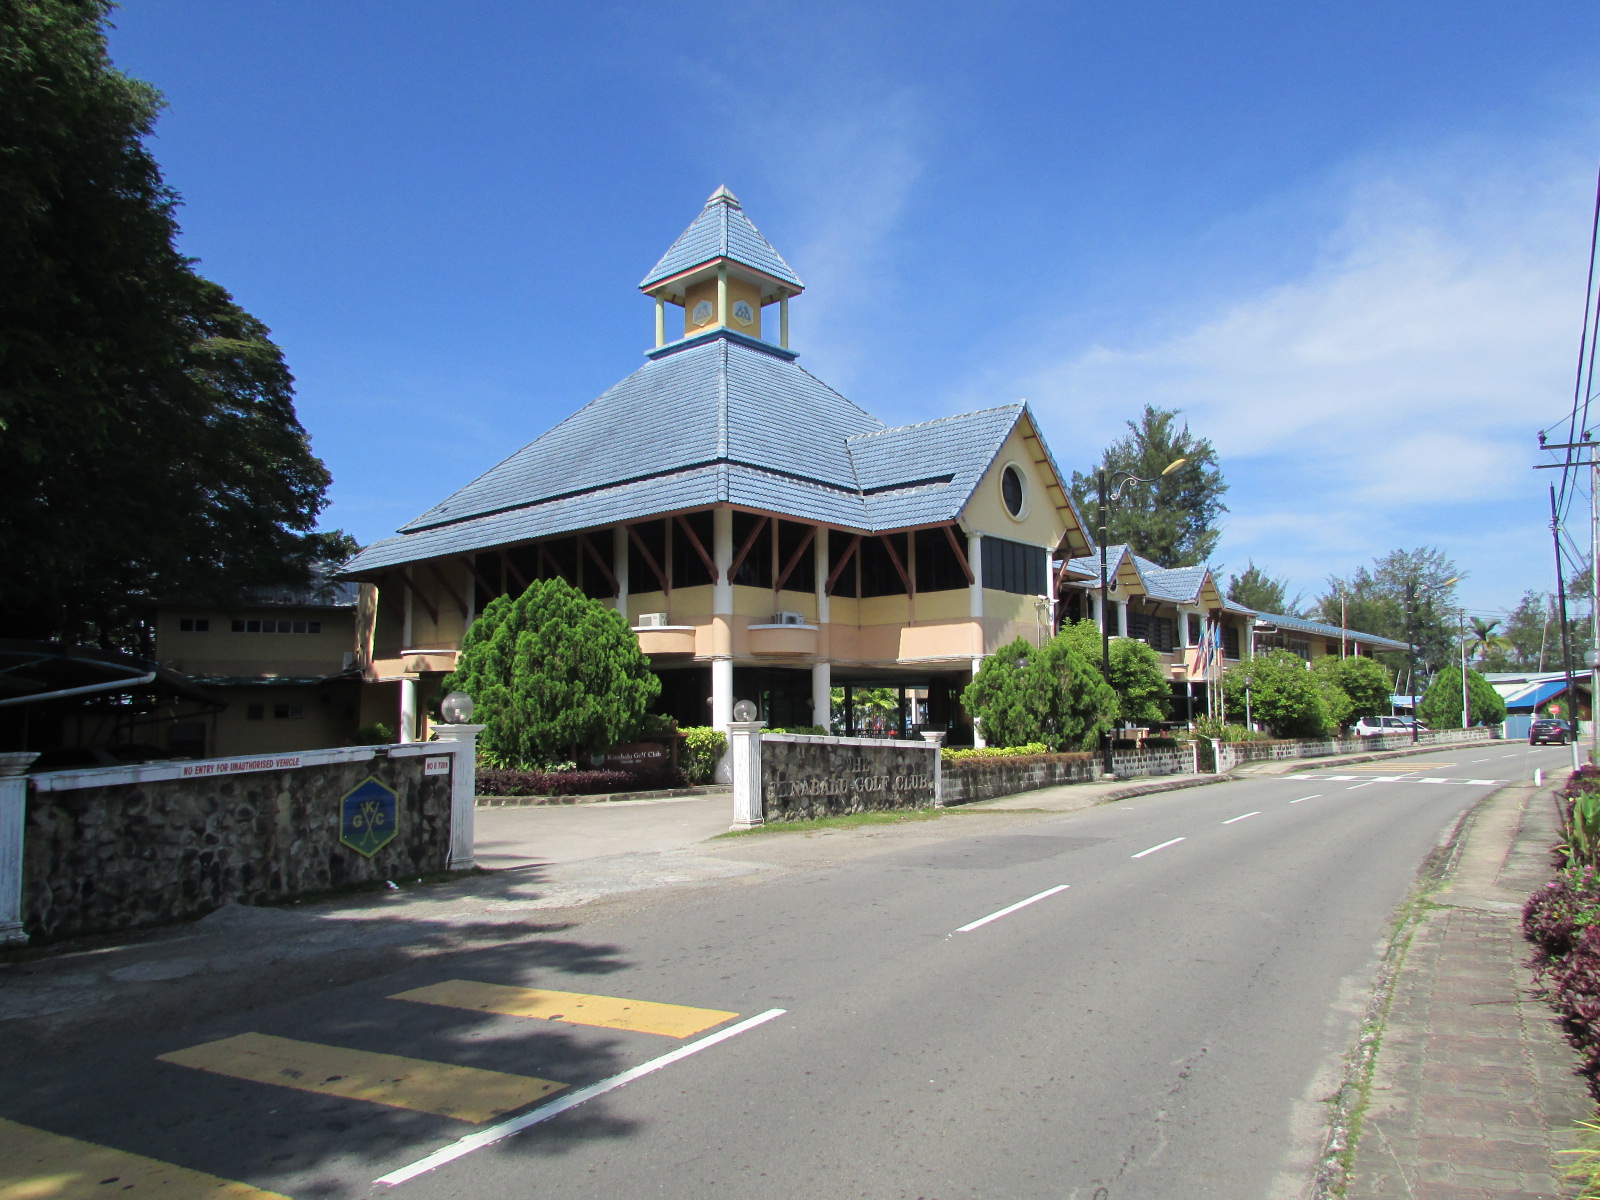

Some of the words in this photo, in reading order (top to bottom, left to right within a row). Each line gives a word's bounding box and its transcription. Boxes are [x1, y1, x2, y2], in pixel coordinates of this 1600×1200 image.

[633, 751, 647, 759] Golf
[647, 750, 662, 758] Club
[183, 766, 193, 776] NO
[194, 764, 215, 775] ENTRY
[216, 763, 228, 773] FOR
[230, 759, 274, 772] UNAUTHORISED
[276, 757, 300, 767] VEHICLE
[426, 762, 434, 770] NO
[843, 757, 870, 773] THE
[854, 775, 889, 793] GOLF
[894, 775, 928, 791] CLUB
[365, 801, 375, 813] K
